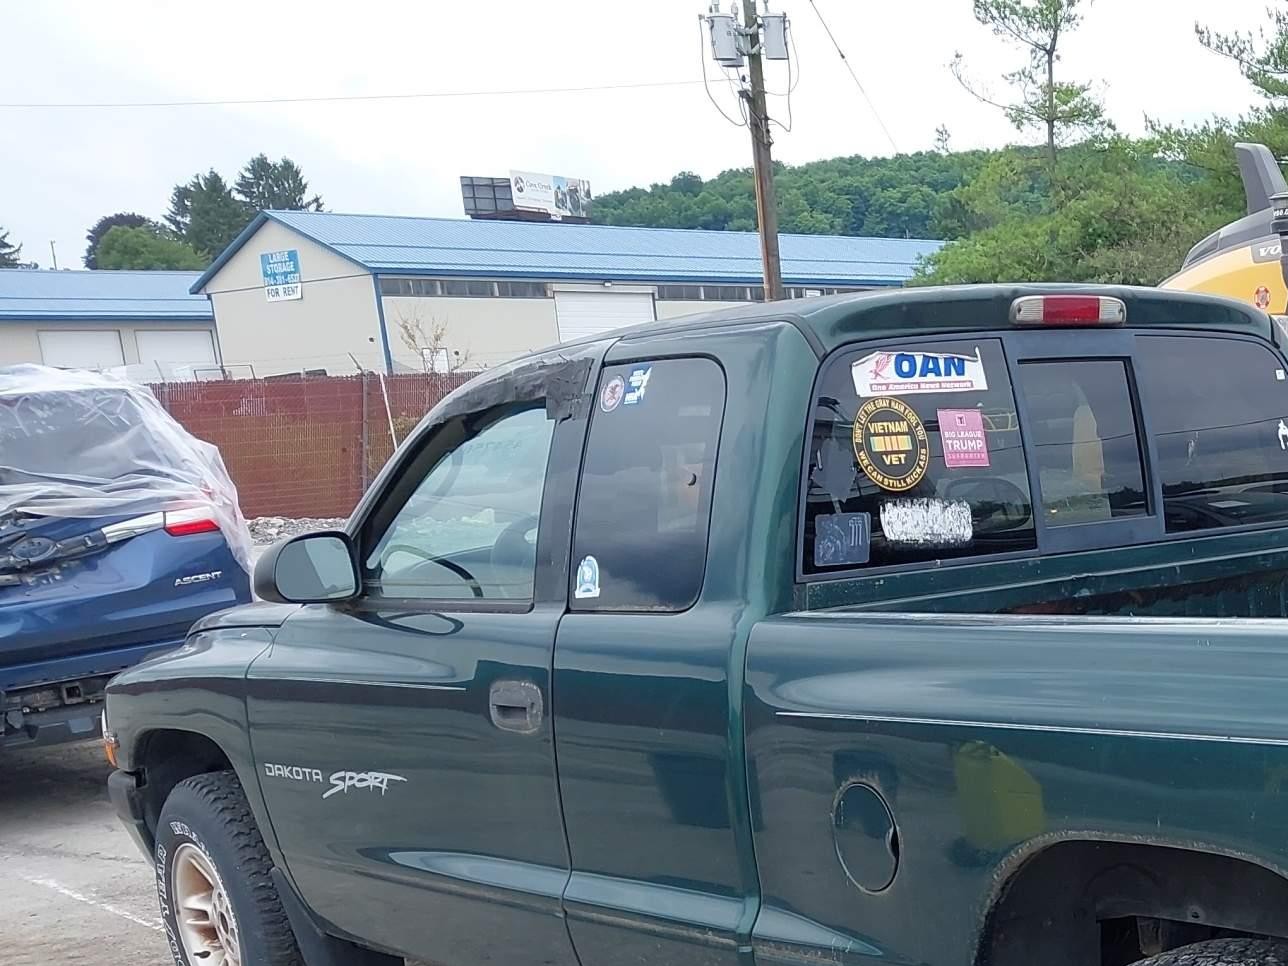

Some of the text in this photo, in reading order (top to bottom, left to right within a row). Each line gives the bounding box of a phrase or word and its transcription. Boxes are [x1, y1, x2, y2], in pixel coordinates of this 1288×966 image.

[268, 251, 289, 263] LARGE
[266, 261, 296, 275] STORAGE
[267, 285, 299, 299] FOR RENT
[894, 353, 965, 378] OAN
[871, 380, 972, 391] One America News Network
[858, 411, 868, 423] LET
[864, 401, 876, 414] THE
[875, 399, 890, 408] GRAY
[890, 399, 905, 412] HAIR
[904, 407, 918, 427] FOOL
[916, 426, 926, 440] YOU
[868, 421, 909, 433] VIETNAM
[957, 430, 982, 438] LEAGUE
[946, 440, 983, 451] TRUMP
[882, 454, 906, 465] VET
[859, 448, 926, 488] WE CAN STILL KICK ASS
[175, 571, 222, 586] ASCENT
[264, 763, 408, 800] DAKOTA SPORT
